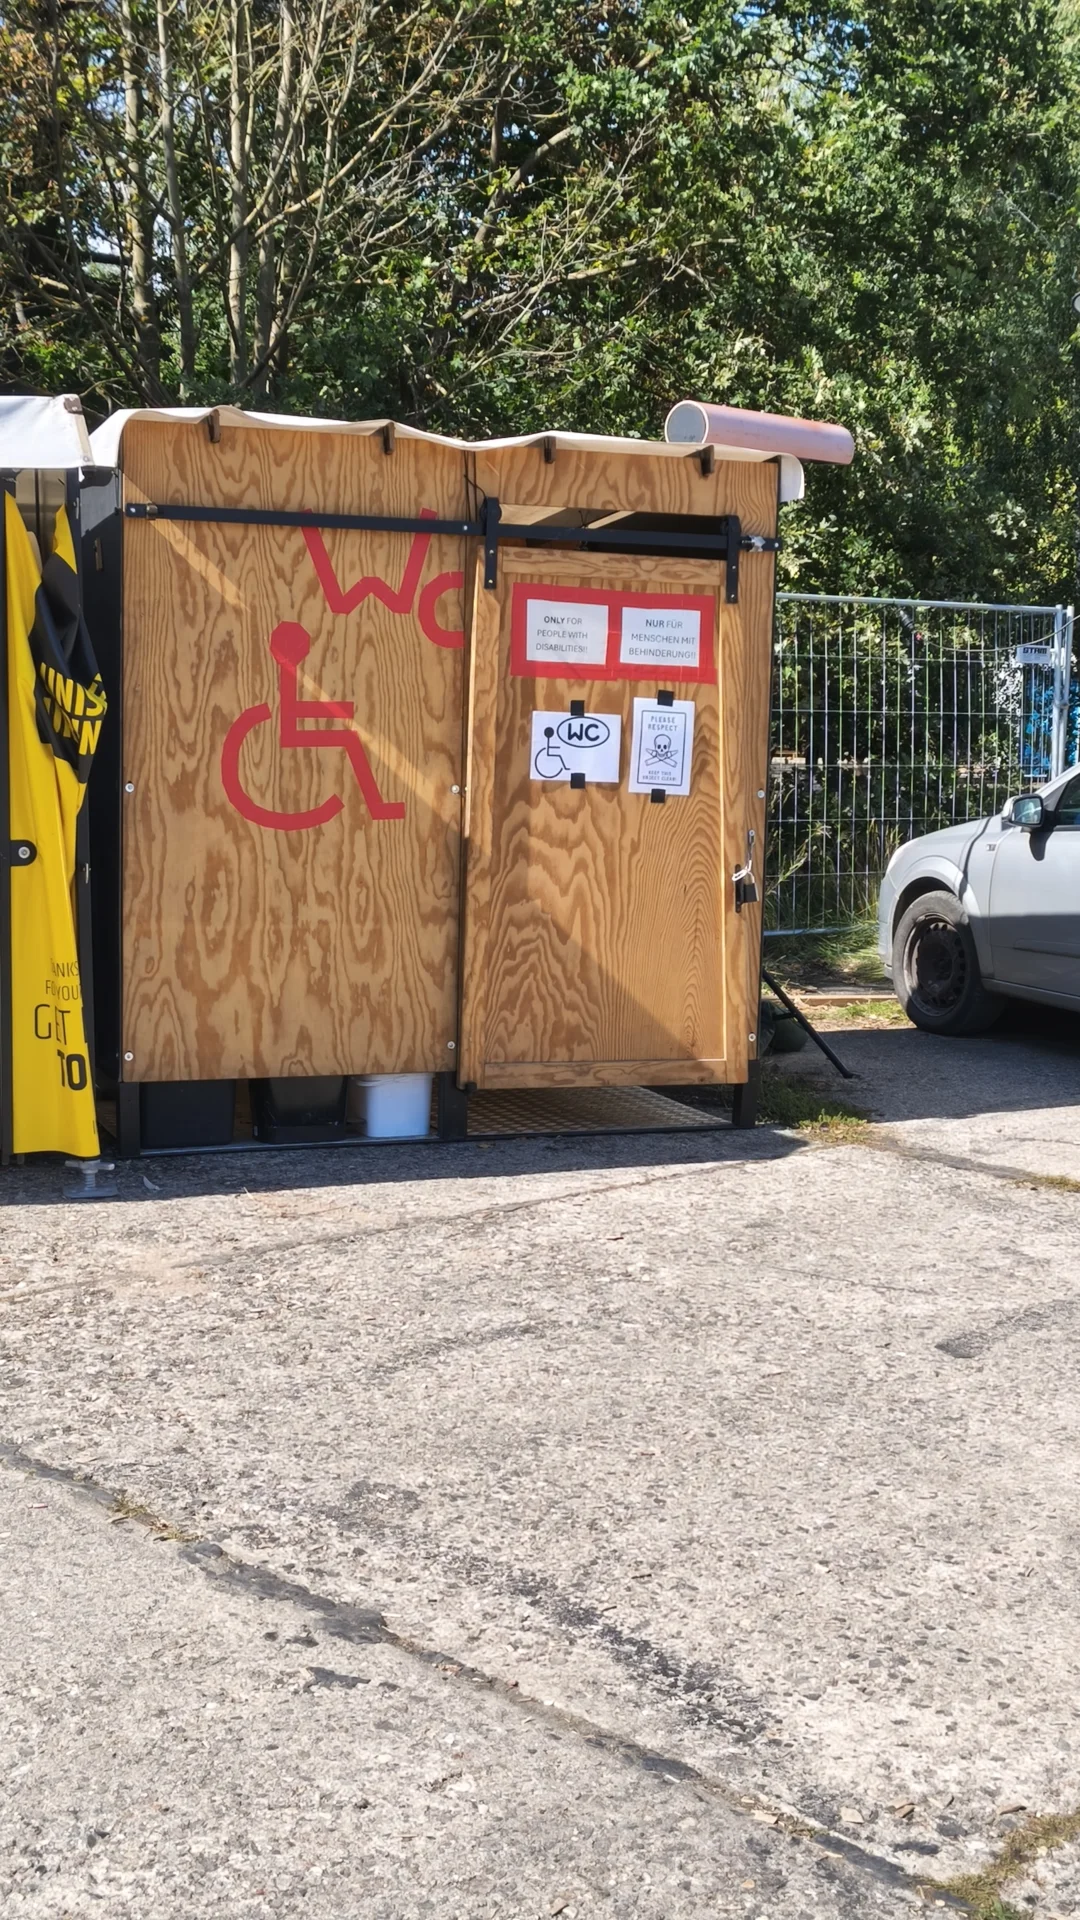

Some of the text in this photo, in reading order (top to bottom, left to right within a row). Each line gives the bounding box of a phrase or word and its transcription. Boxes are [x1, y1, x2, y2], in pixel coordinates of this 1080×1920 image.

[543, 615, 583, 626] ONLY FOR
[645, 618, 683, 629] NUR FÜR
[536, 629, 588, 640] PEOPLE WITH
[631, 633, 696, 646] MENSCHEN MIT
[535, 643, 588, 654] DISABILITIES!!
[628, 647, 696, 660] BEHINDERUNG!!
[650, 715, 676, 725] PLEASE
[567, 722, 600, 743] WC
[648, 723, 678, 733] RESPECT
[50, 960, 79, 977] ANKS
[34, 1003, 71, 1046] GET
[57, 1049, 88, 1091] TO
